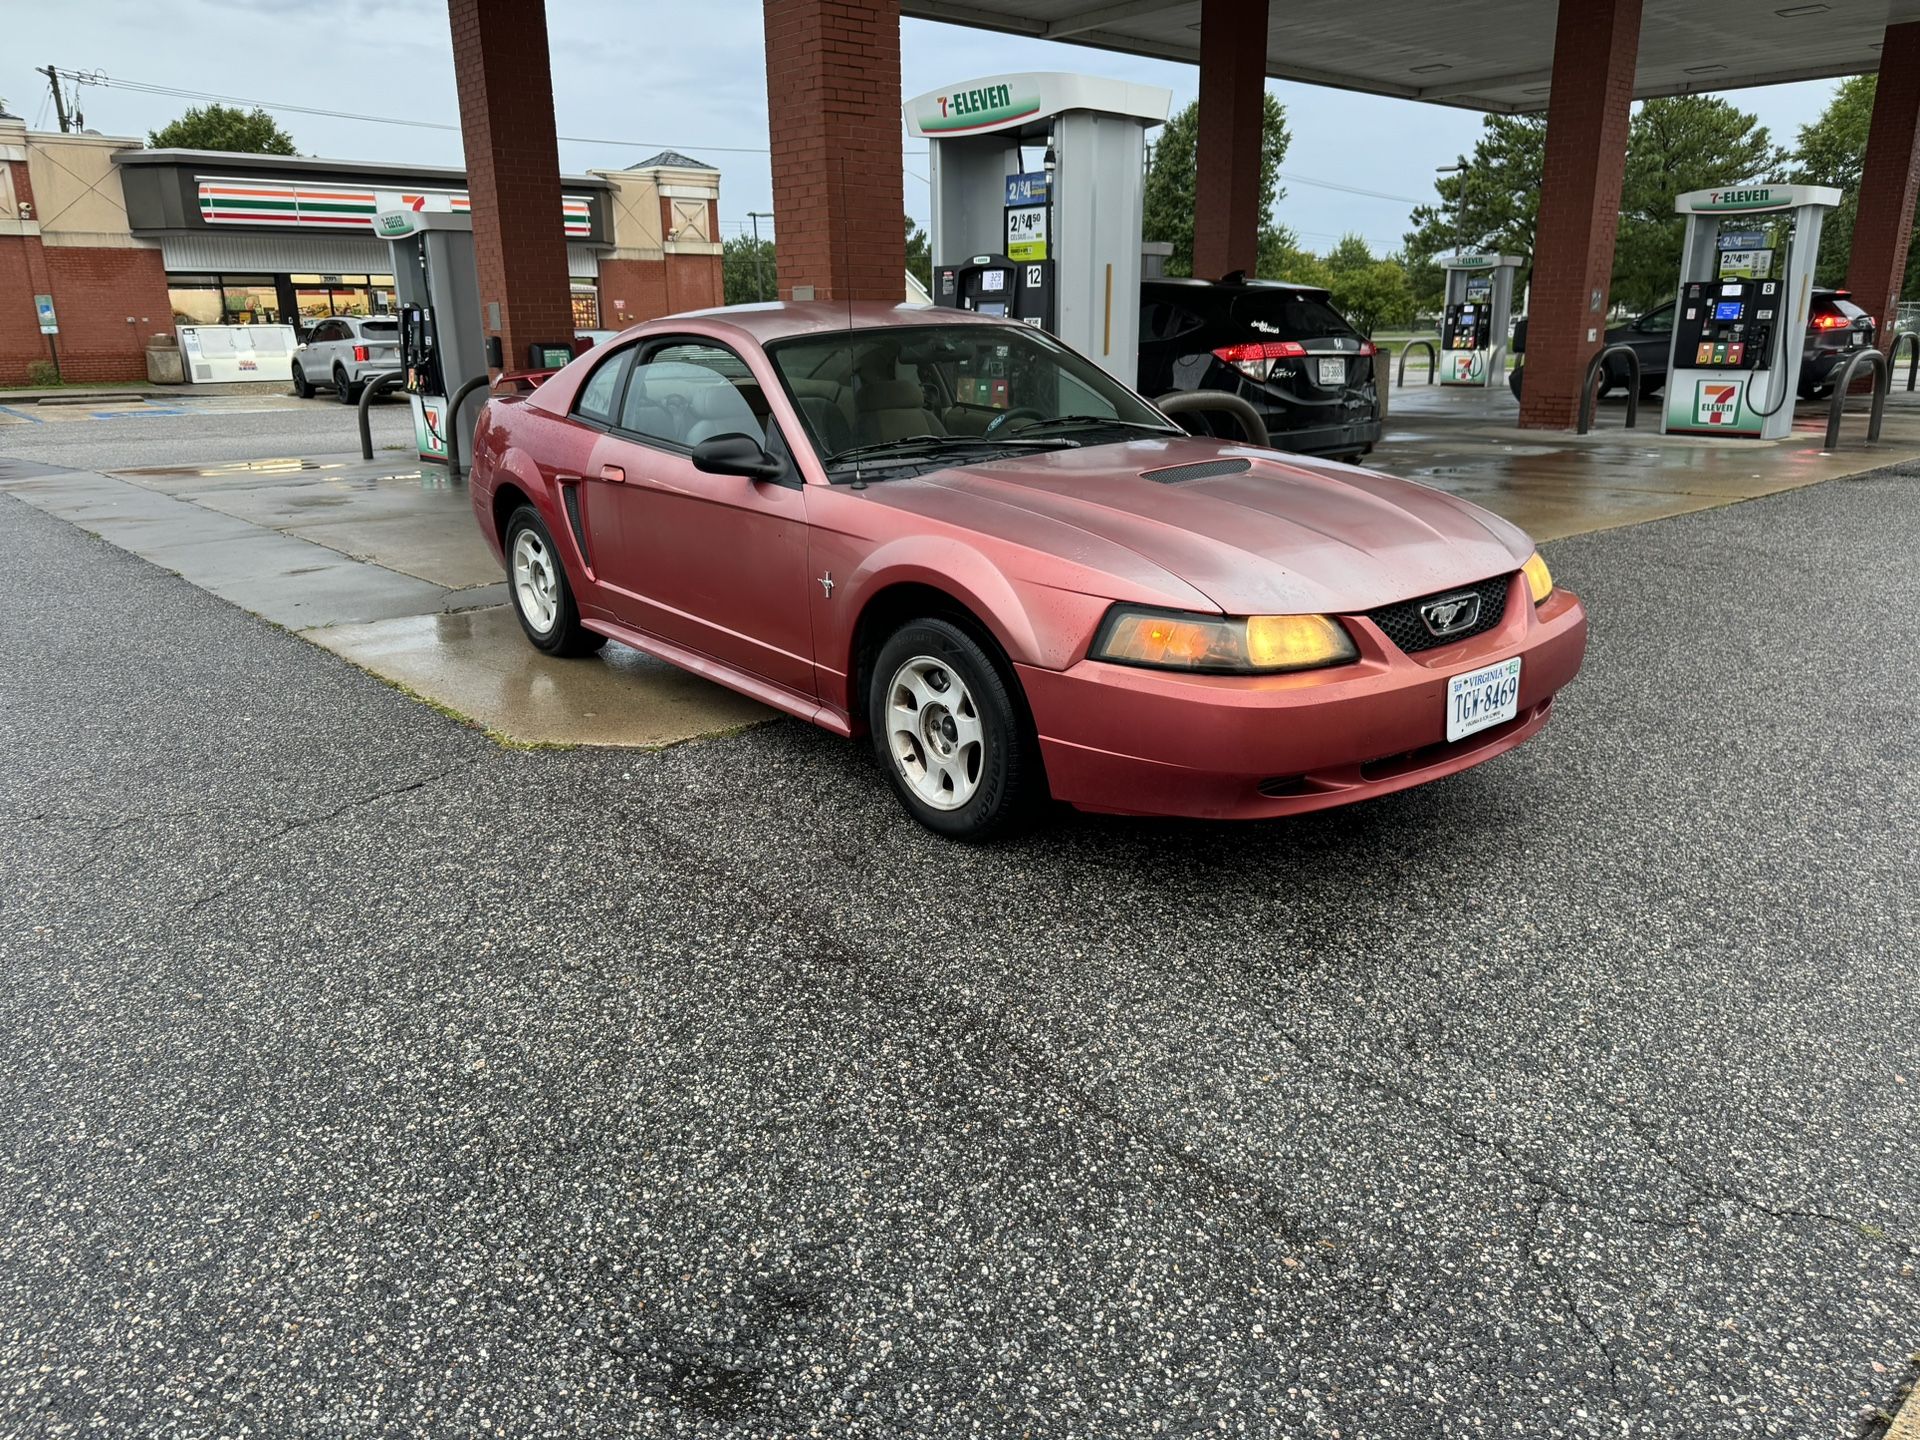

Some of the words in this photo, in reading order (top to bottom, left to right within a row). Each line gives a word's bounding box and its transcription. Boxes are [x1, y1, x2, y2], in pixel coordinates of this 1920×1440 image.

[1028, 267, 1041, 285] 12
[1765, 284, 1773, 293] 8
[1704, 386, 1735, 423] 7
[1469, 668, 1503, 687] VIRGINIA
[1455, 677, 1516, 723] TGW-8469
